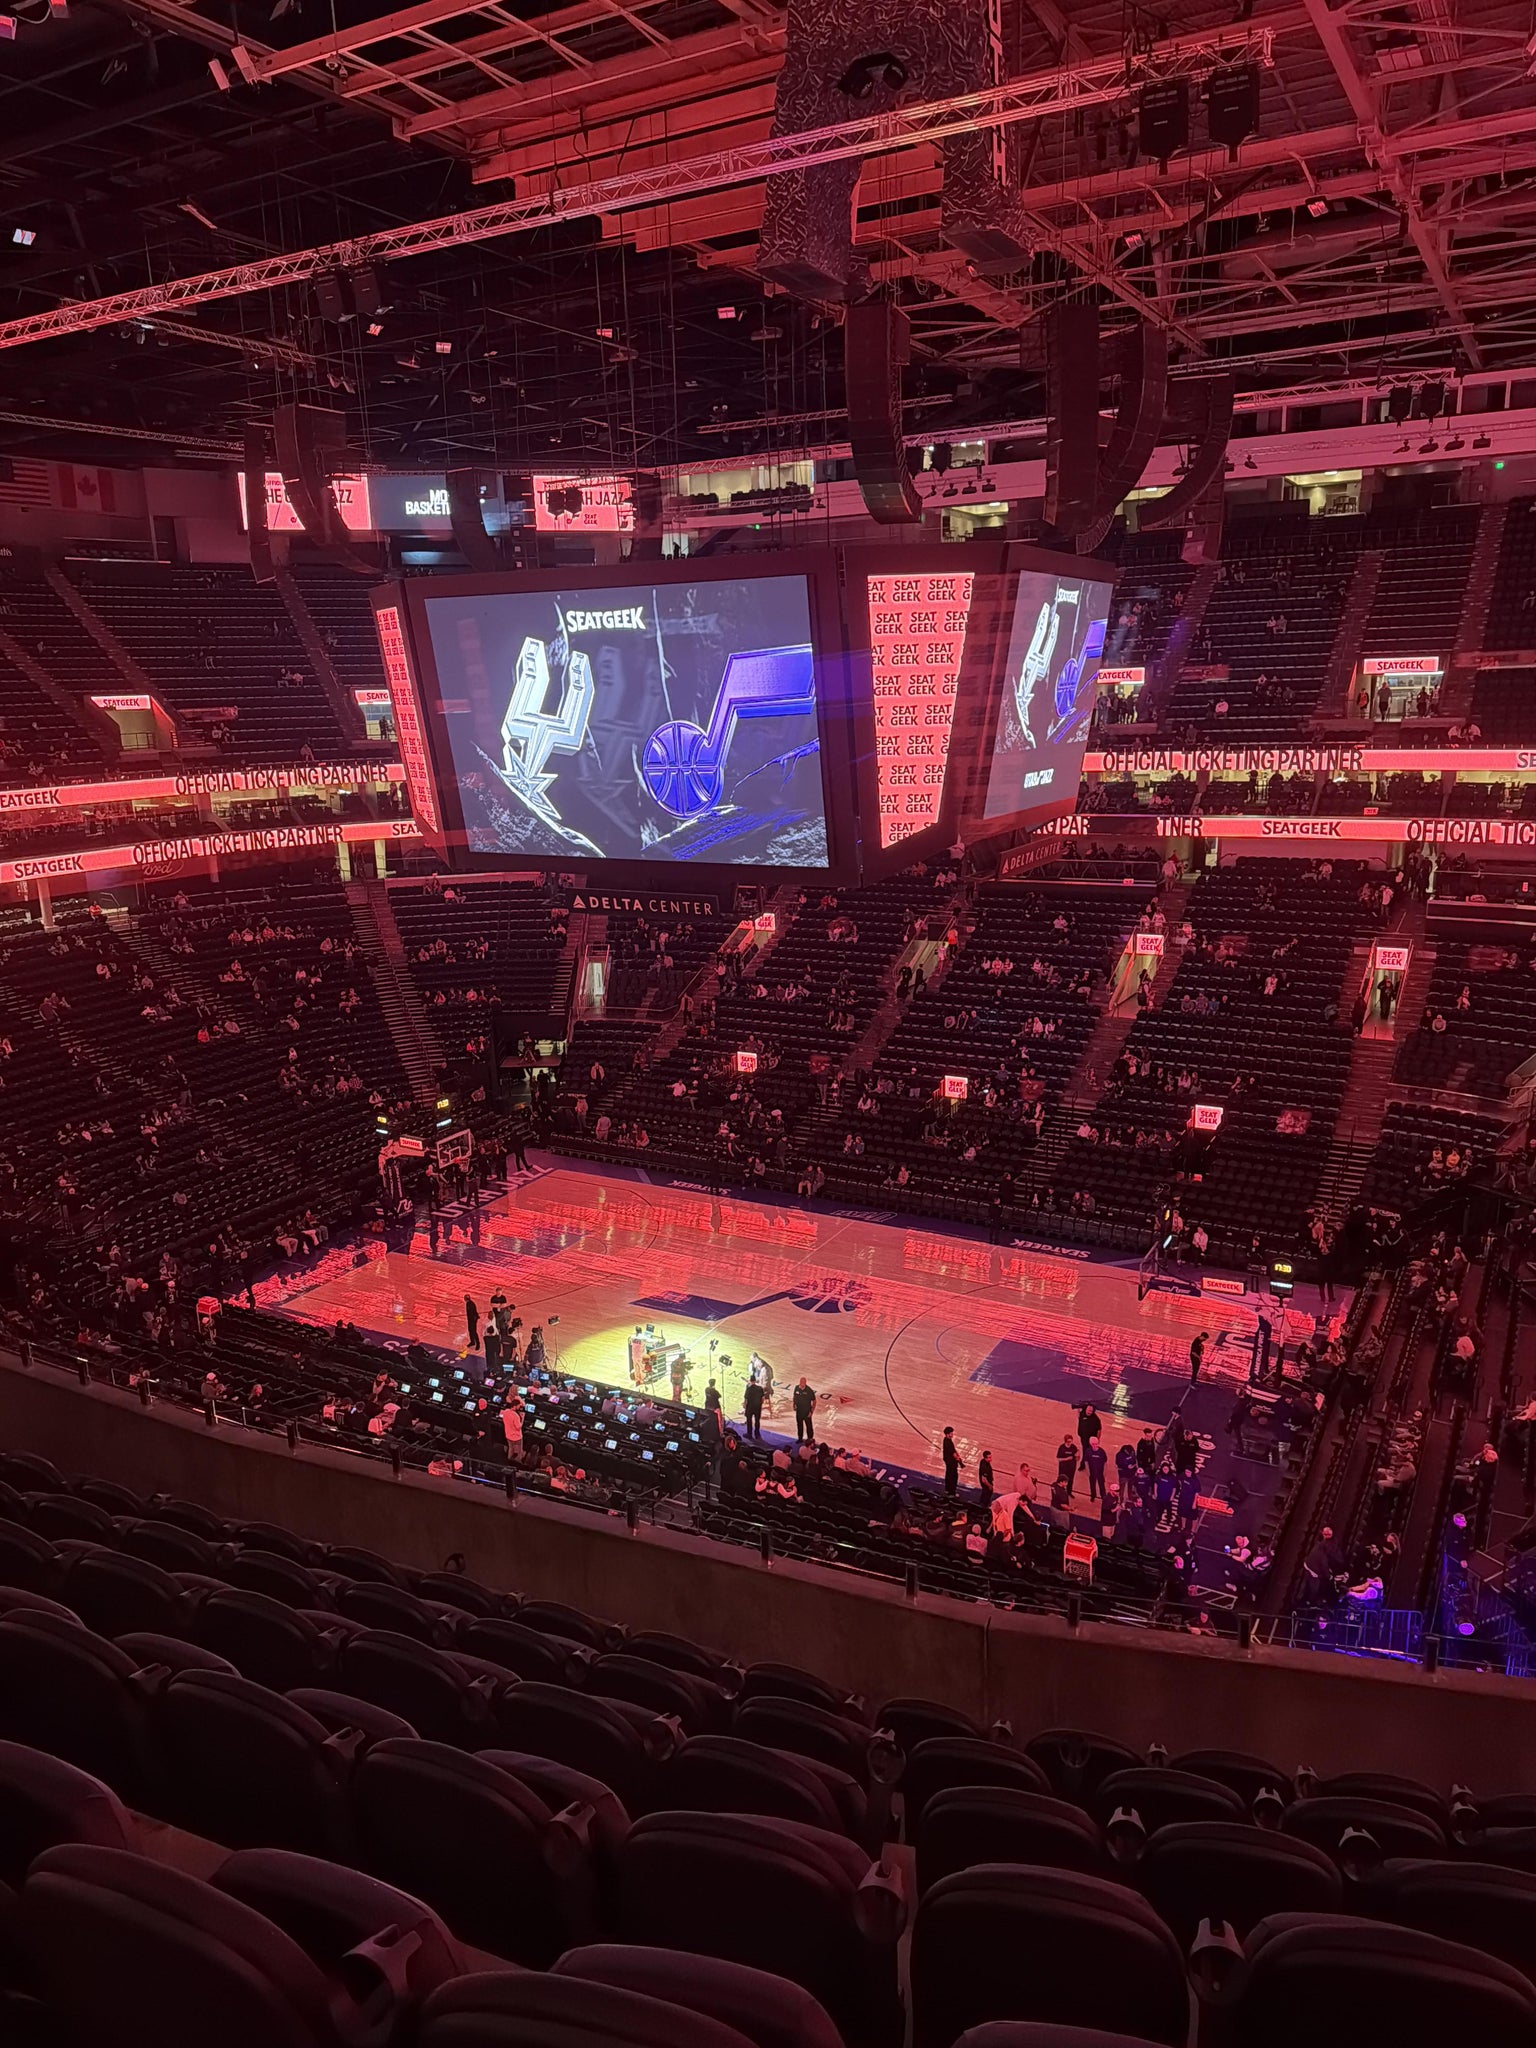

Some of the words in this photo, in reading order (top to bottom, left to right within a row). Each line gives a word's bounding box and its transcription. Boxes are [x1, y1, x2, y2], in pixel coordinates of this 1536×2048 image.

[596, 491, 624, 505] JAZZ
[894, 580, 920, 591] SEAT
[929, 579, 956, 590] SEAT
[892, 591, 921, 602] GEEK
[927, 590, 956, 601] GEEK
[565, 606, 646, 633] SEATGEEK
[876, 613, 902, 623] SEAT
[911, 612, 937, 622] SEAT
[875, 624, 903, 634] GEEK
[909, 623, 937, 633] GEEK
[893, 643, 919, 654] SEAT
[928, 642, 954, 653] SEAT
[891, 655, 920, 665] GEEK
[926, 653, 954, 664] GEEK
[1377, 660, 1424, 671] SEATGEEK
[875, 675, 901, 686] SEAT
[909, 674, 936, 685] SEAT
[1099, 670, 1132, 680] EATGEEK
[366, 692, 388, 700] SEATG
[874, 686, 902, 696] GEEK
[908, 685, 936, 695] GEEK
[103, 698, 140, 708] SEATGEEK
[892, 705, 918, 715] SEAT
[926, 704, 952, 714] SEAT
[890, 716, 918, 726] GEEK
[924, 714, 952, 725] GEEK
[908, 735, 934, 745] SEAT
[906, 745, 935, 755] GEEK
[1103, 751, 1179, 772] OFFICIAL
[1182, 750, 1275, 772] TICKETING
[1279, 750, 1363, 771] PARTNER
[891, 765, 917, 775] SEAT
[175, 772, 240, 796] OFFICIAL
[242, 767, 319, 791] TICKETING
[321, 764, 389, 786] PARTNER
[889, 775, 917, 785] GEEK
[907, 793, 933, 804] SEAT
[905, 804, 933, 813] GEEK
[890, 822, 915, 832] SEAT
[1262, 820, 1342, 837] SEATGEEK
[1407, 820, 1497, 844] OFFICIAL
[132, 840, 200, 865] OFFICIAL
[200, 831, 276, 857] TICKETING
[278, 824, 343, 849] PARTNER
[1010, 850, 1034, 870] DELTA
[14, 855, 85, 879] SEATGEEK
[589, 896, 644, 912] DELTA
[649, 899, 713, 916] CENTER
[1382, 951, 1403, 959] SEAT
[1380, 958, 1402, 966] GEEK
